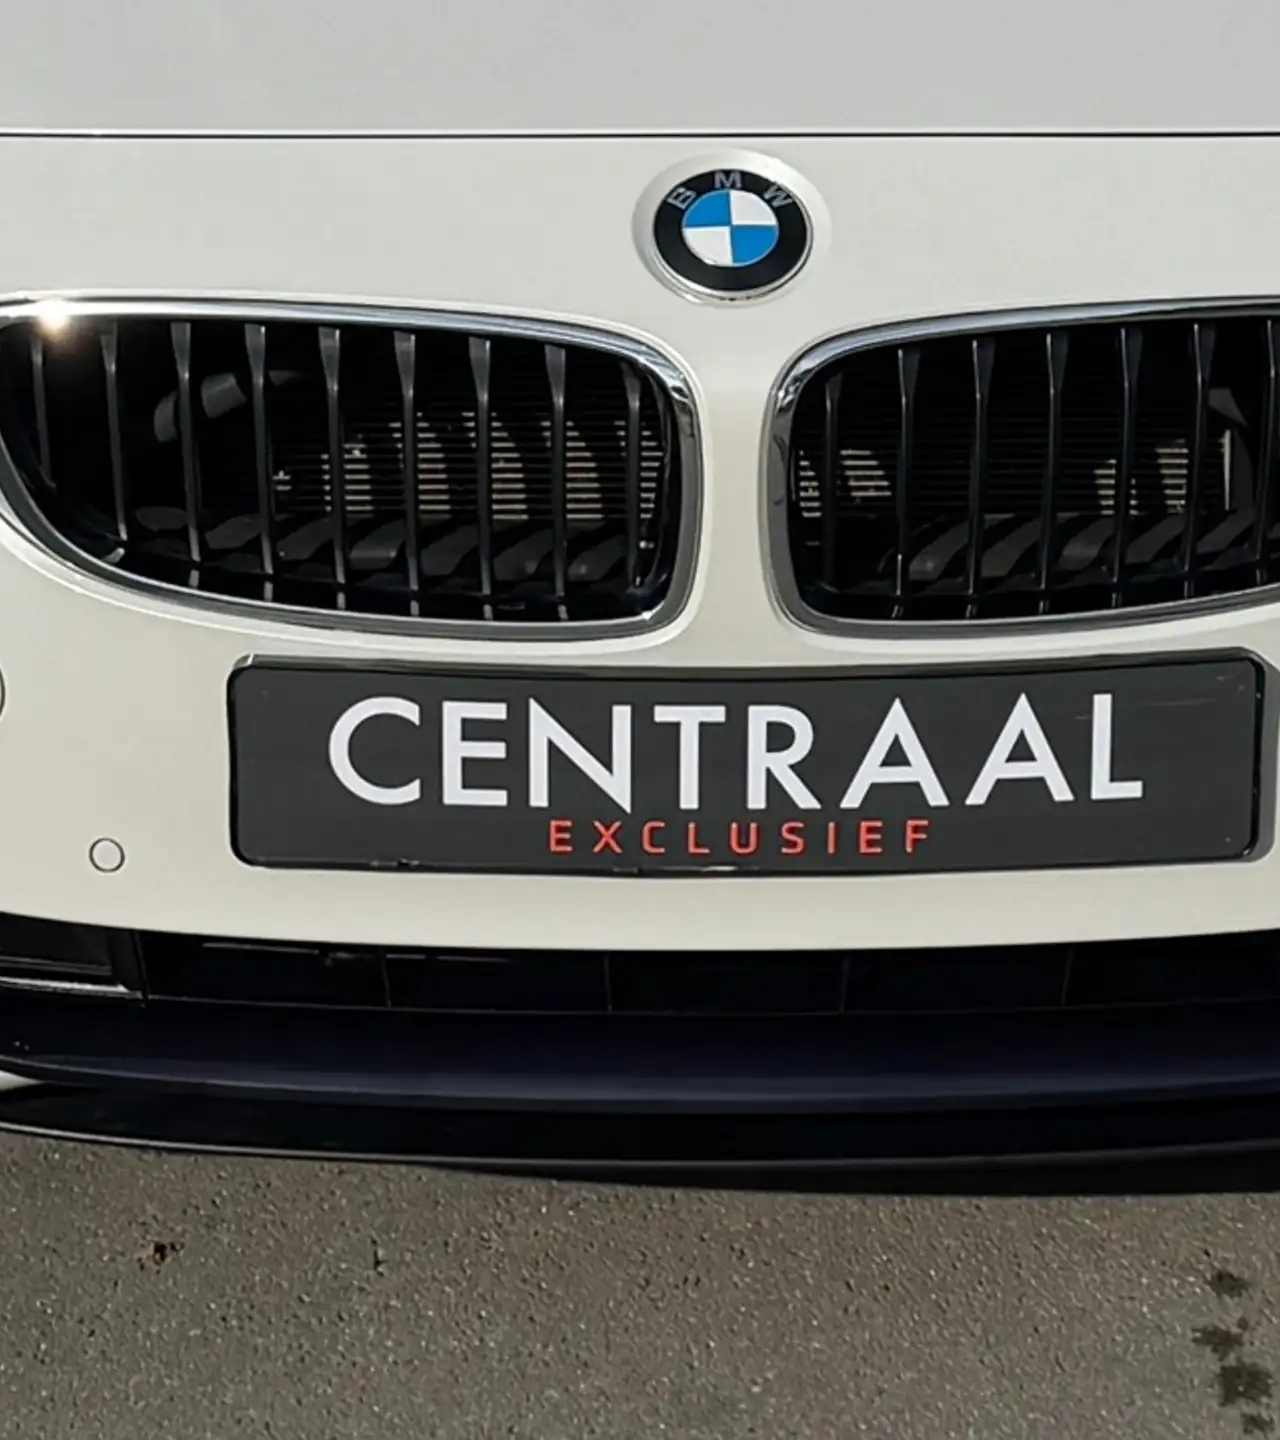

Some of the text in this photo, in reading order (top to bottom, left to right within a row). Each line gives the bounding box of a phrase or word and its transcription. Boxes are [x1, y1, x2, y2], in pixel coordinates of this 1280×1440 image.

[667, 171, 793, 210] BMW
[328, 693, 1144, 814] CENTRAAL
[548, 819, 931, 856] EXCLUSIEF
